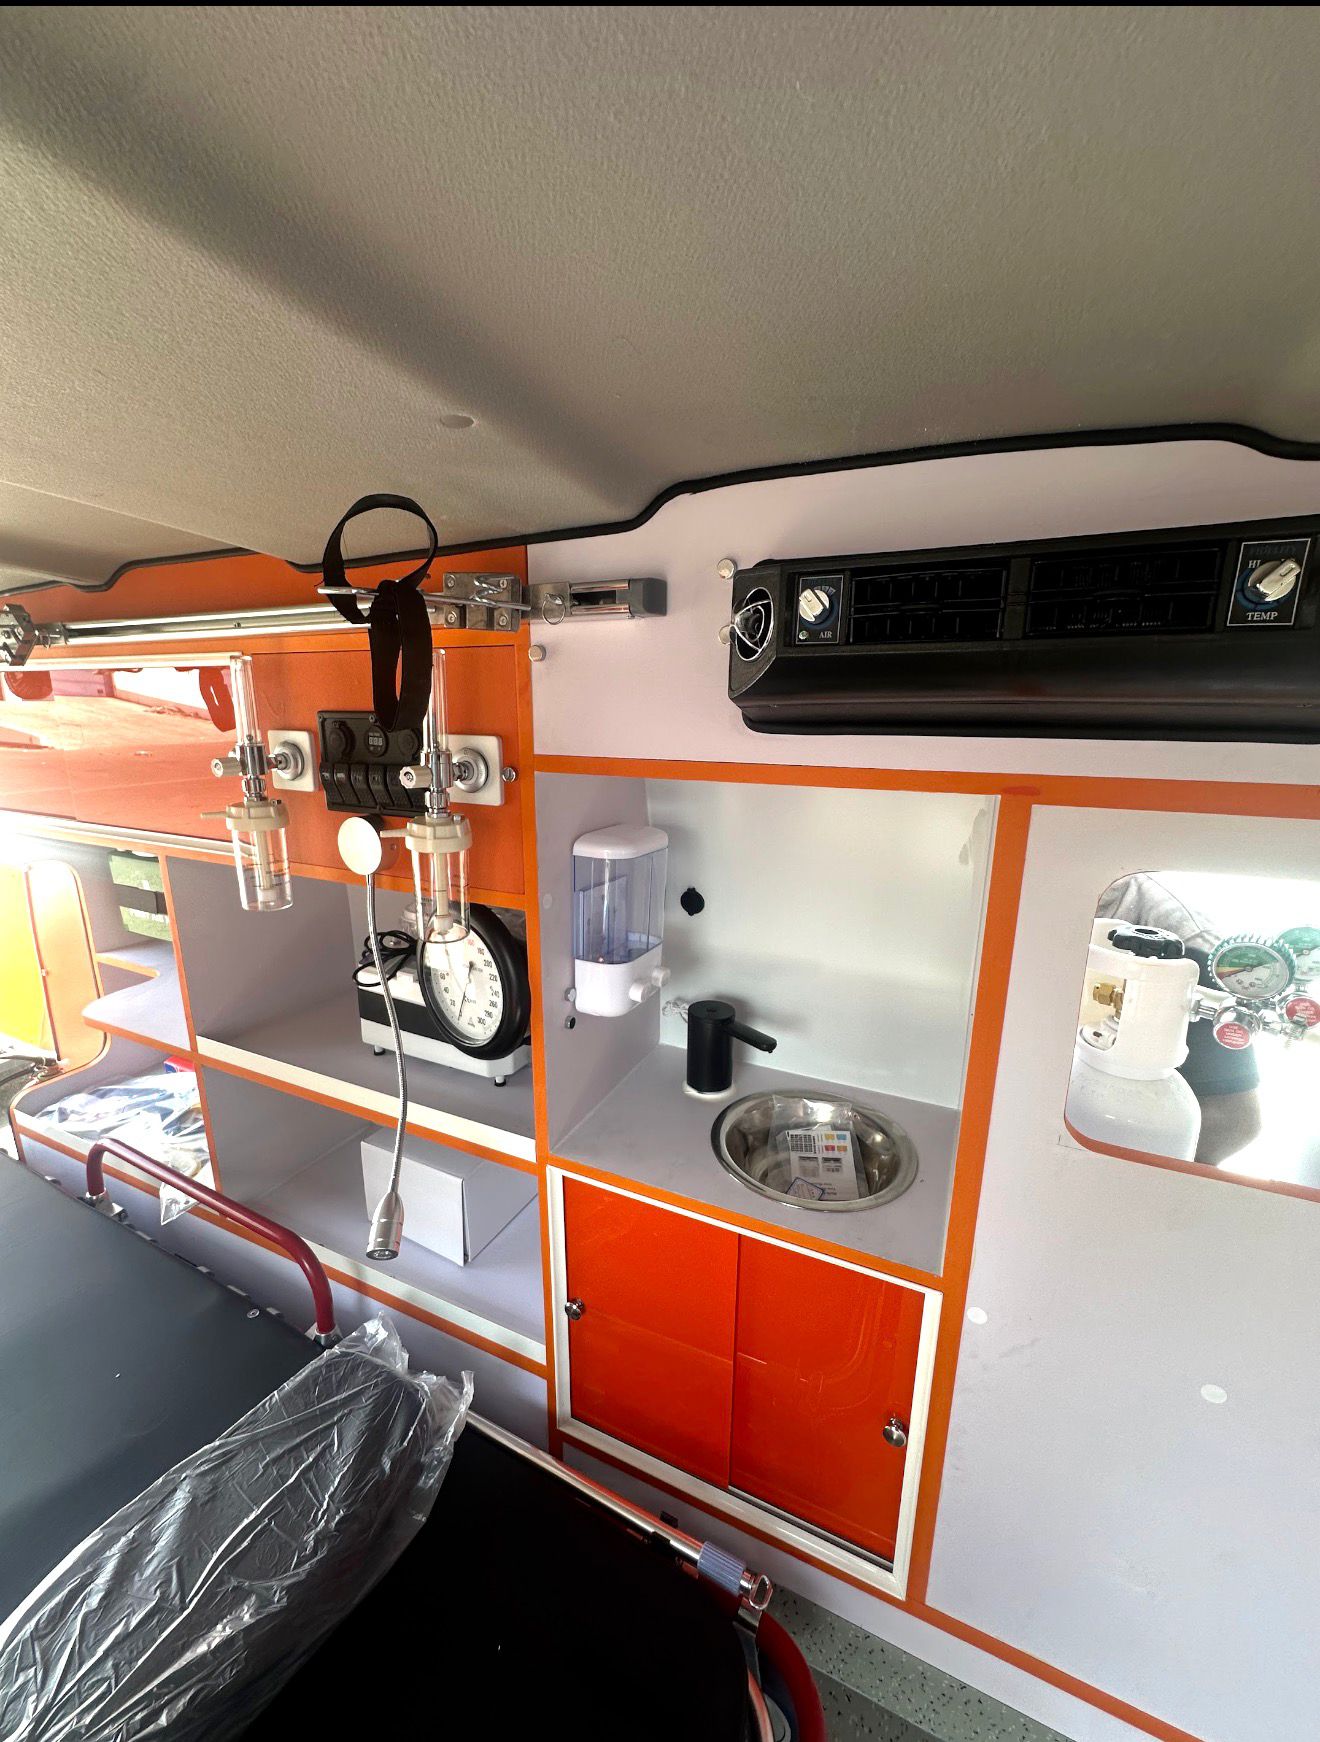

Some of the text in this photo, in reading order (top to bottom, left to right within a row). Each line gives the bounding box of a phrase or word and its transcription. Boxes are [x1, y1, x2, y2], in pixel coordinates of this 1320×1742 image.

[1248, 559, 1261, 569] HI
[1247, 611, 1278, 621] TEMP
[819, 631, 833, 639] AIR
[484, 959, 493, 968] 200
[489, 973, 498, 982] 220
